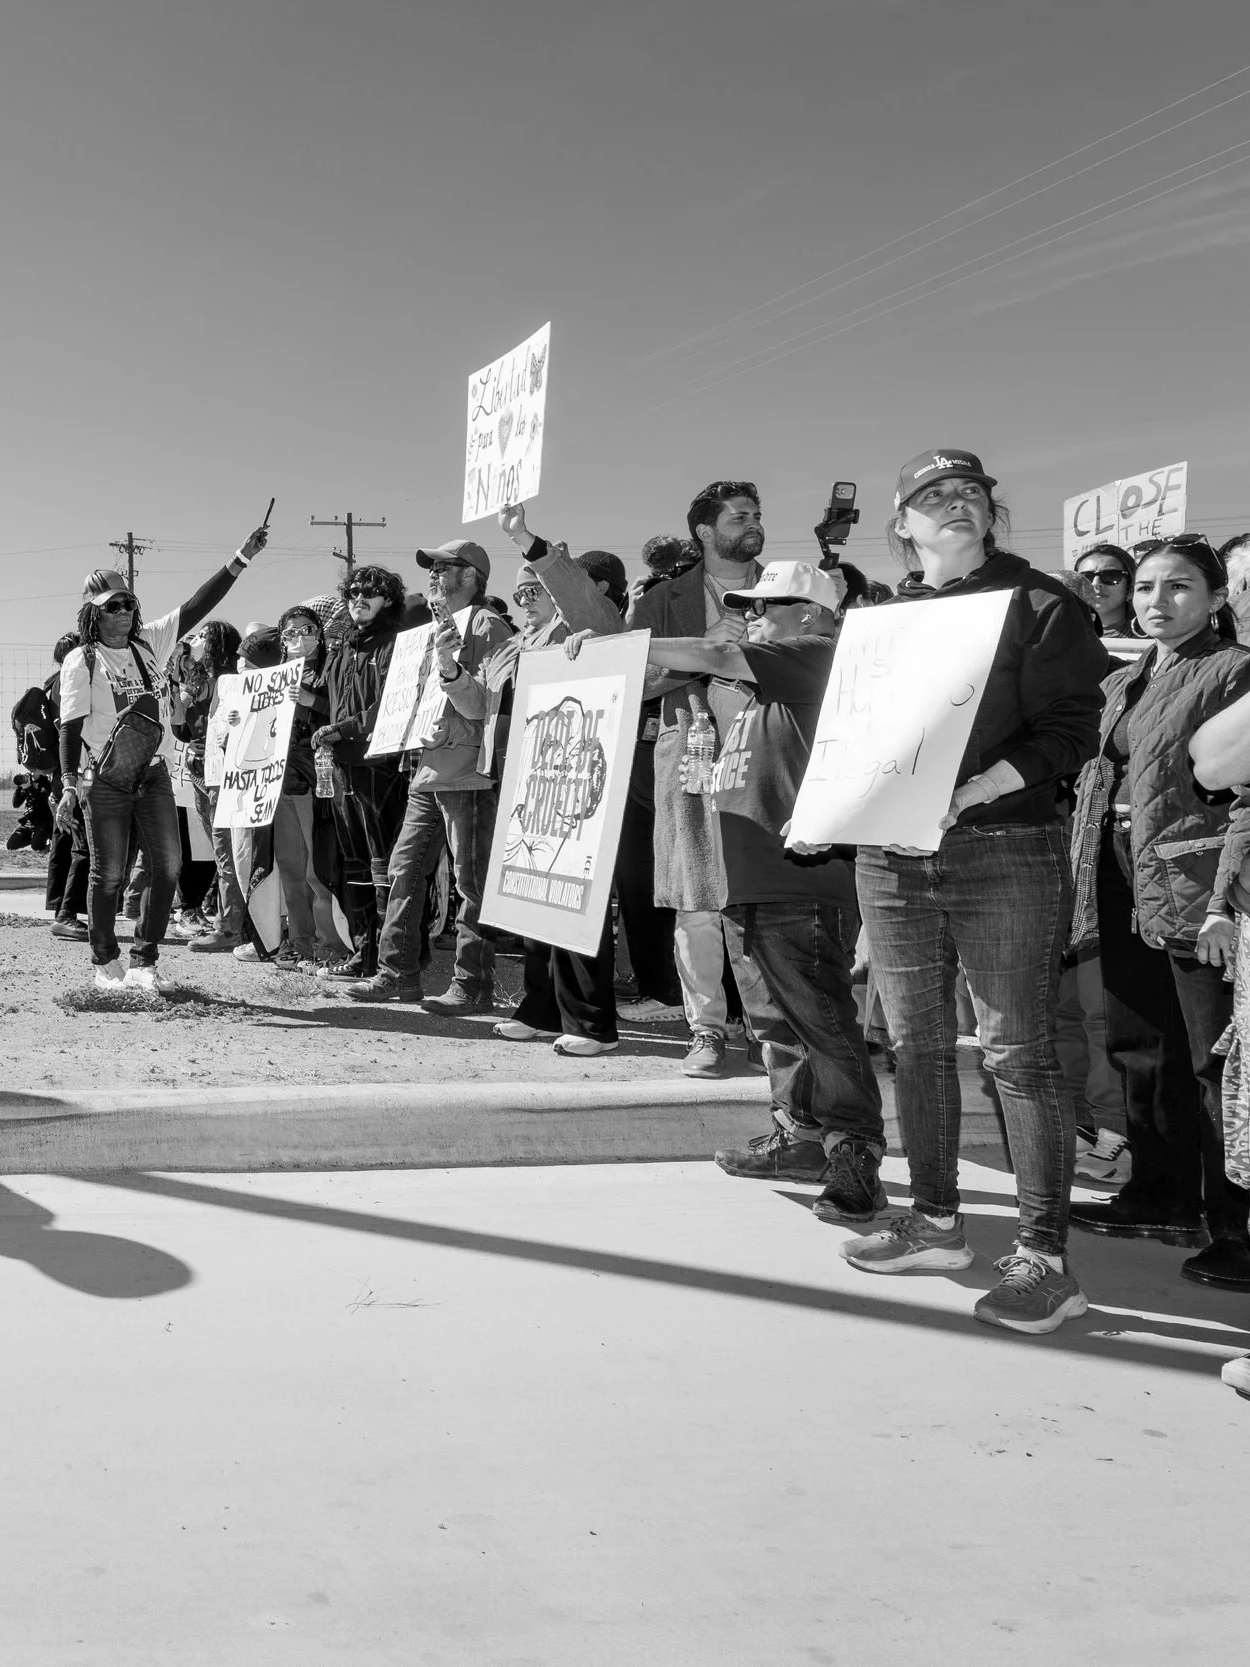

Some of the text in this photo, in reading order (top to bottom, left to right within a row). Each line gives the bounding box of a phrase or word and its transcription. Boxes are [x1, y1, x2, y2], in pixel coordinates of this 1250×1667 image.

[1073, 466, 1184, 537] CLOSE
[1120, 518, 1163, 541] THE
[242, 664, 301, 695] NO SOMOS
[223, 758, 285, 791] HASTA TODOS
[253, 784, 268, 802] LO
[522, 774, 594, 841] CRUELTY
[250, 796, 277, 824] SEAN
[502, 870, 584, 910] CONSTITUTIONAL VIOLATORS
